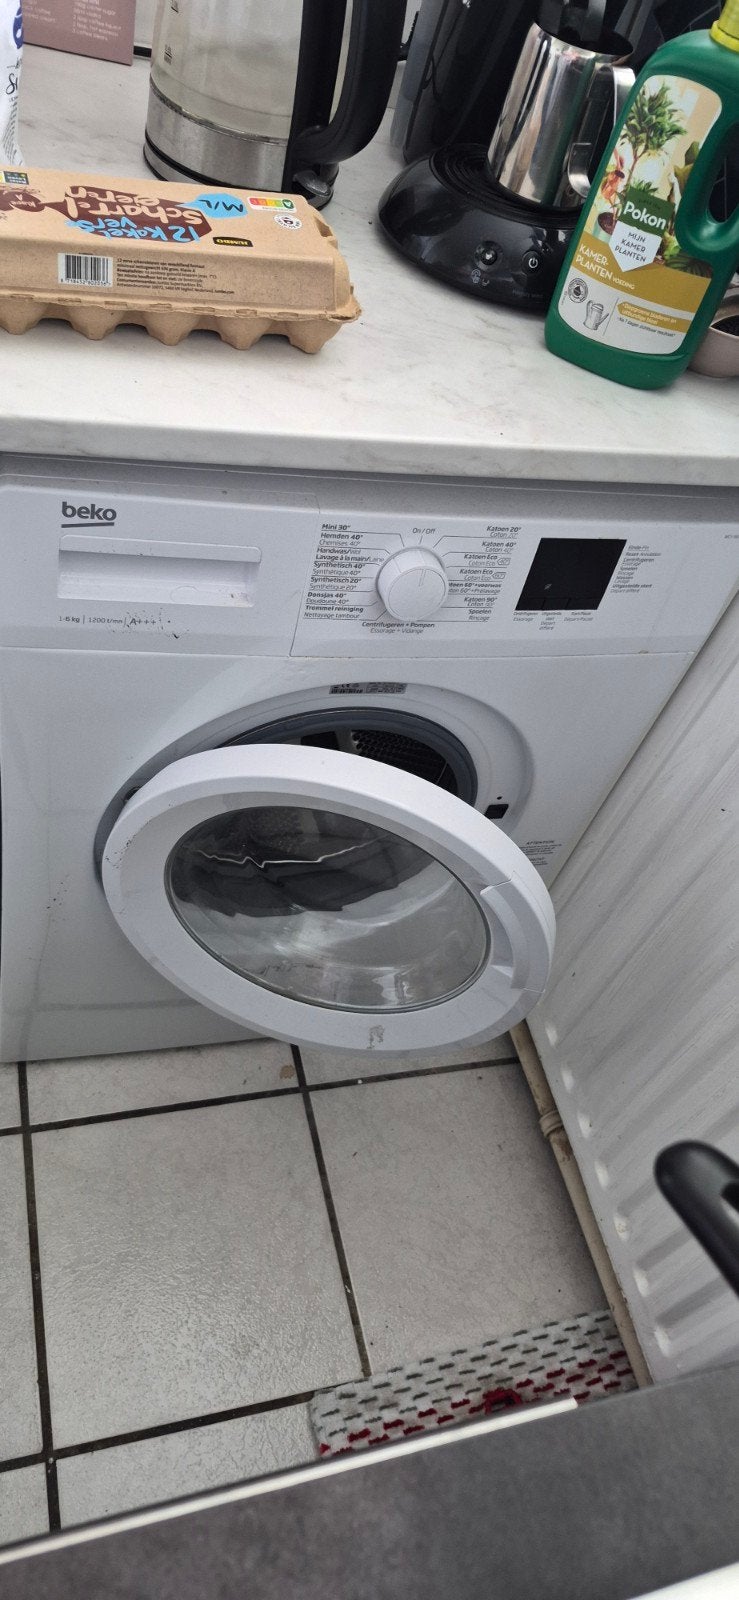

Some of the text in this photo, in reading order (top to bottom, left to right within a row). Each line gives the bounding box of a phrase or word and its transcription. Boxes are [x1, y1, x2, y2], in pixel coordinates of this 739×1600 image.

[64, 197, 202, 225] Scharrel
[623, 201, 667, 230] Pokon
[168, 226, 200, 243] 12
[628, 232, 646, 243] MIJN
[615, 245, 646, 262] PLANTEN
[621, 238, 646, 252] KAMER
[580, 244, 608, 266] KAMER-
[576, 255, 613, 280] PLANTEN
[61, 501, 117, 521] beko
[361, 621, 405, 629] Centrifugeren
